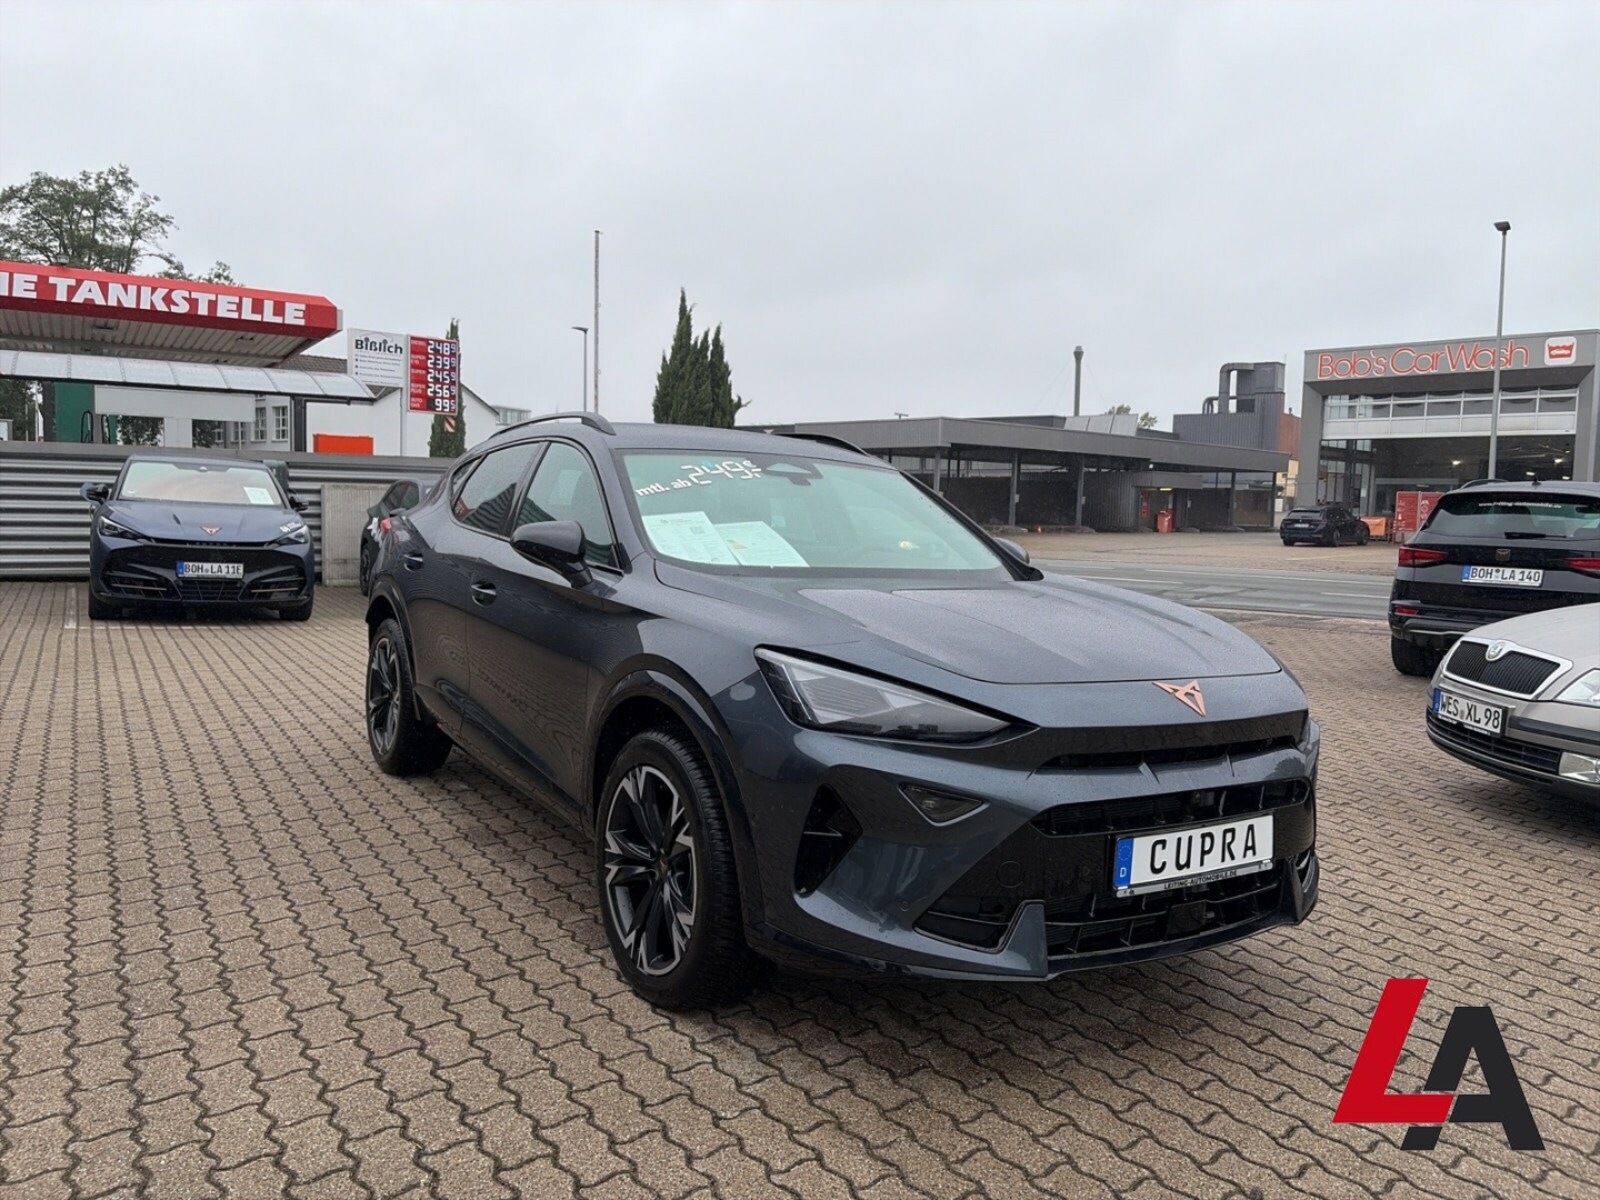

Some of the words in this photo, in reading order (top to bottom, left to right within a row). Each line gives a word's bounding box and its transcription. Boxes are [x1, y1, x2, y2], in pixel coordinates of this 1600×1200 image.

[49, 276, 306, 326] TANKSTELLE
[355, 337, 403, 354] Bißlich
[1317, 350, 1387, 380] Bob's
[1389, 346, 1444, 375] Car
[1445, 338, 1530, 372] Wash
[635, 482, 670, 496] mtl.
[671, 478, 693, 489] ab
[184, 563, 204, 573] BOH
[210, 564, 223, 575] LA
[225, 565, 242, 575] 11E
[1471, 567, 1493, 579] BOH
[1501, 569, 1516, 580] LA
[1519, 571, 1541, 582] 140
[1440, 693, 1460, 716] WES
[1465, 702, 1481, 724] XL
[1484, 708, 1501, 729] 98
[1119, 867, 1127, 878] D
[1150, 823, 1257, 875] CUPRA
